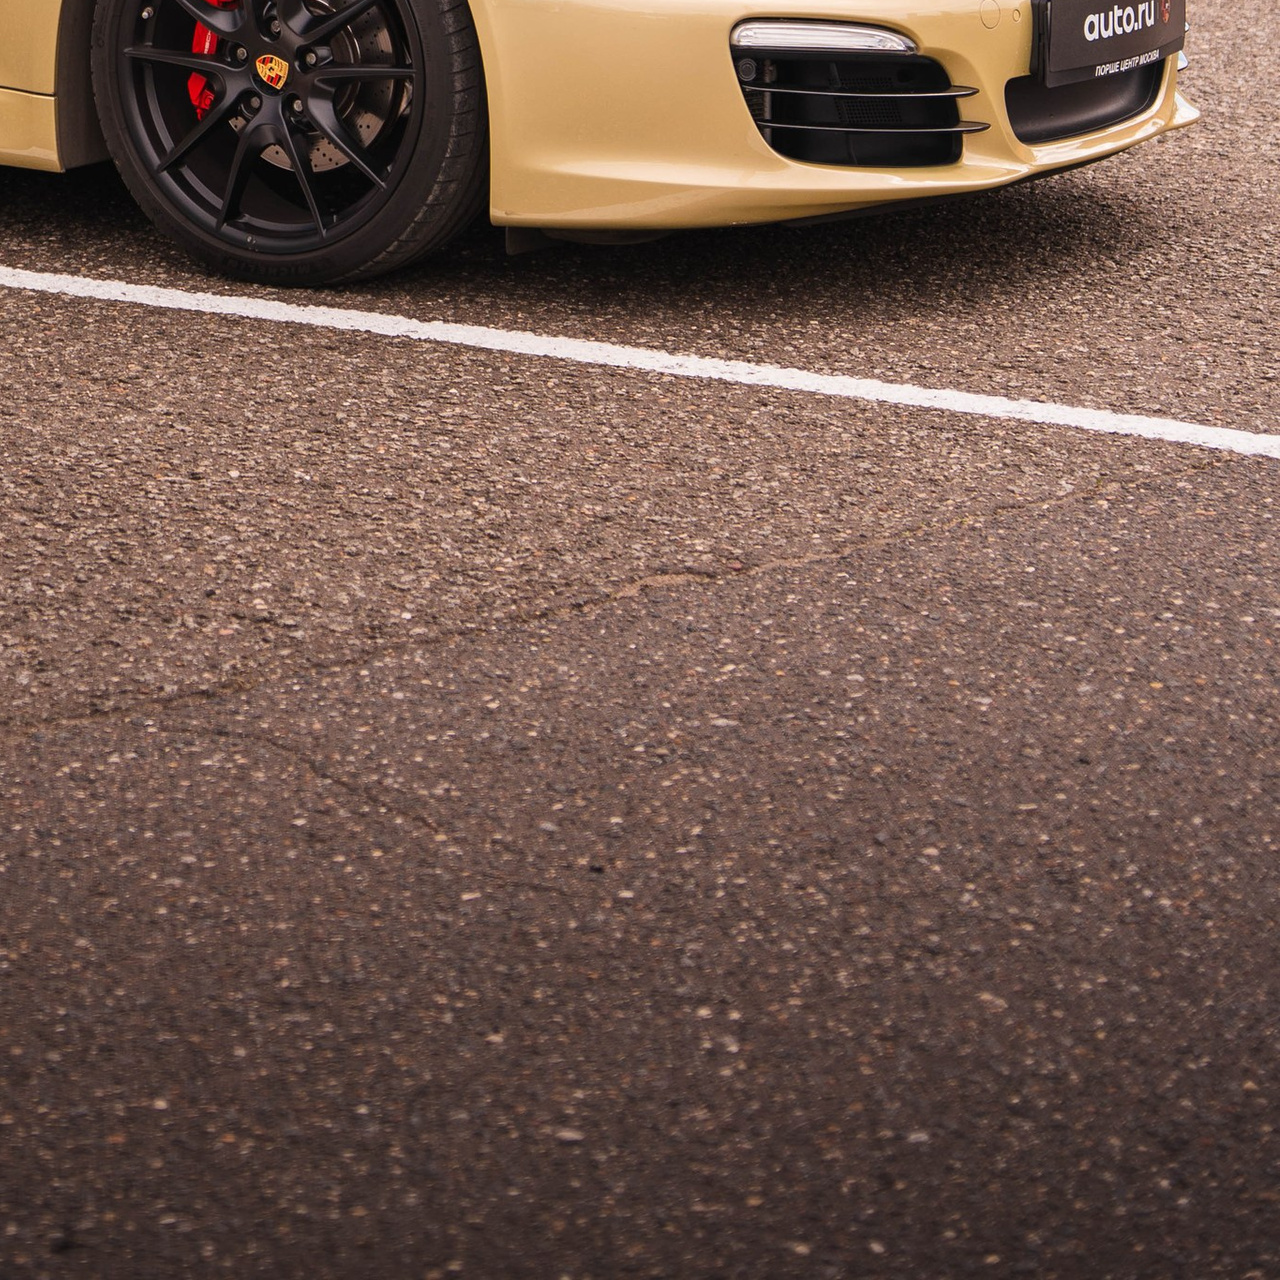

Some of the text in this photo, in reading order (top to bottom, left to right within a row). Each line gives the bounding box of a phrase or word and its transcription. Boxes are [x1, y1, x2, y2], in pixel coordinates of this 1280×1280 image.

[1084, 0, 1154, 41] auto.ru
[1095, 49, 1160, 77] ПОРШЕ ЦЕНТР МОСКВА
